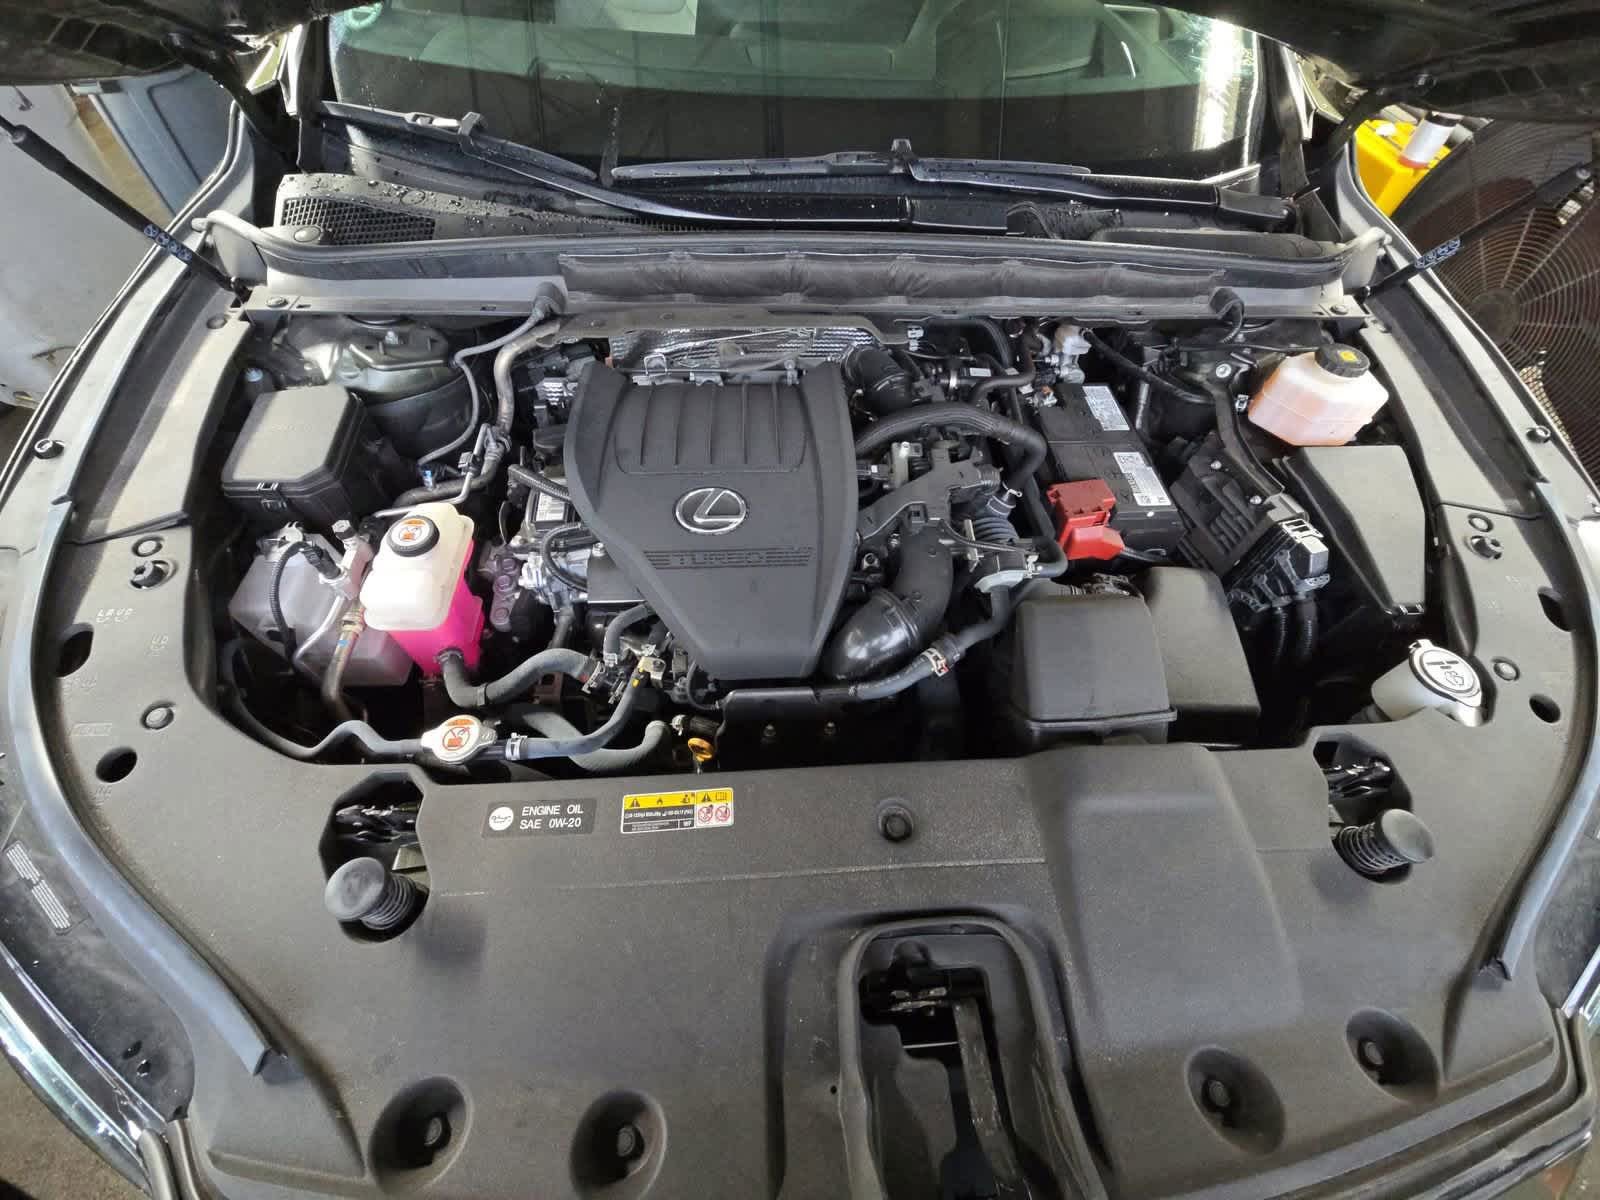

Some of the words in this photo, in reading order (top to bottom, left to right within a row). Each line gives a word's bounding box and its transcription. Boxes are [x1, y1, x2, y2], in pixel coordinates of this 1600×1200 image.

[521, 805, 561, 816] ENGINE
[567, 804, 583, 814] OIL
[520, 819, 542, 829] SAE
[549, 817, 582, 828] 0W-20
